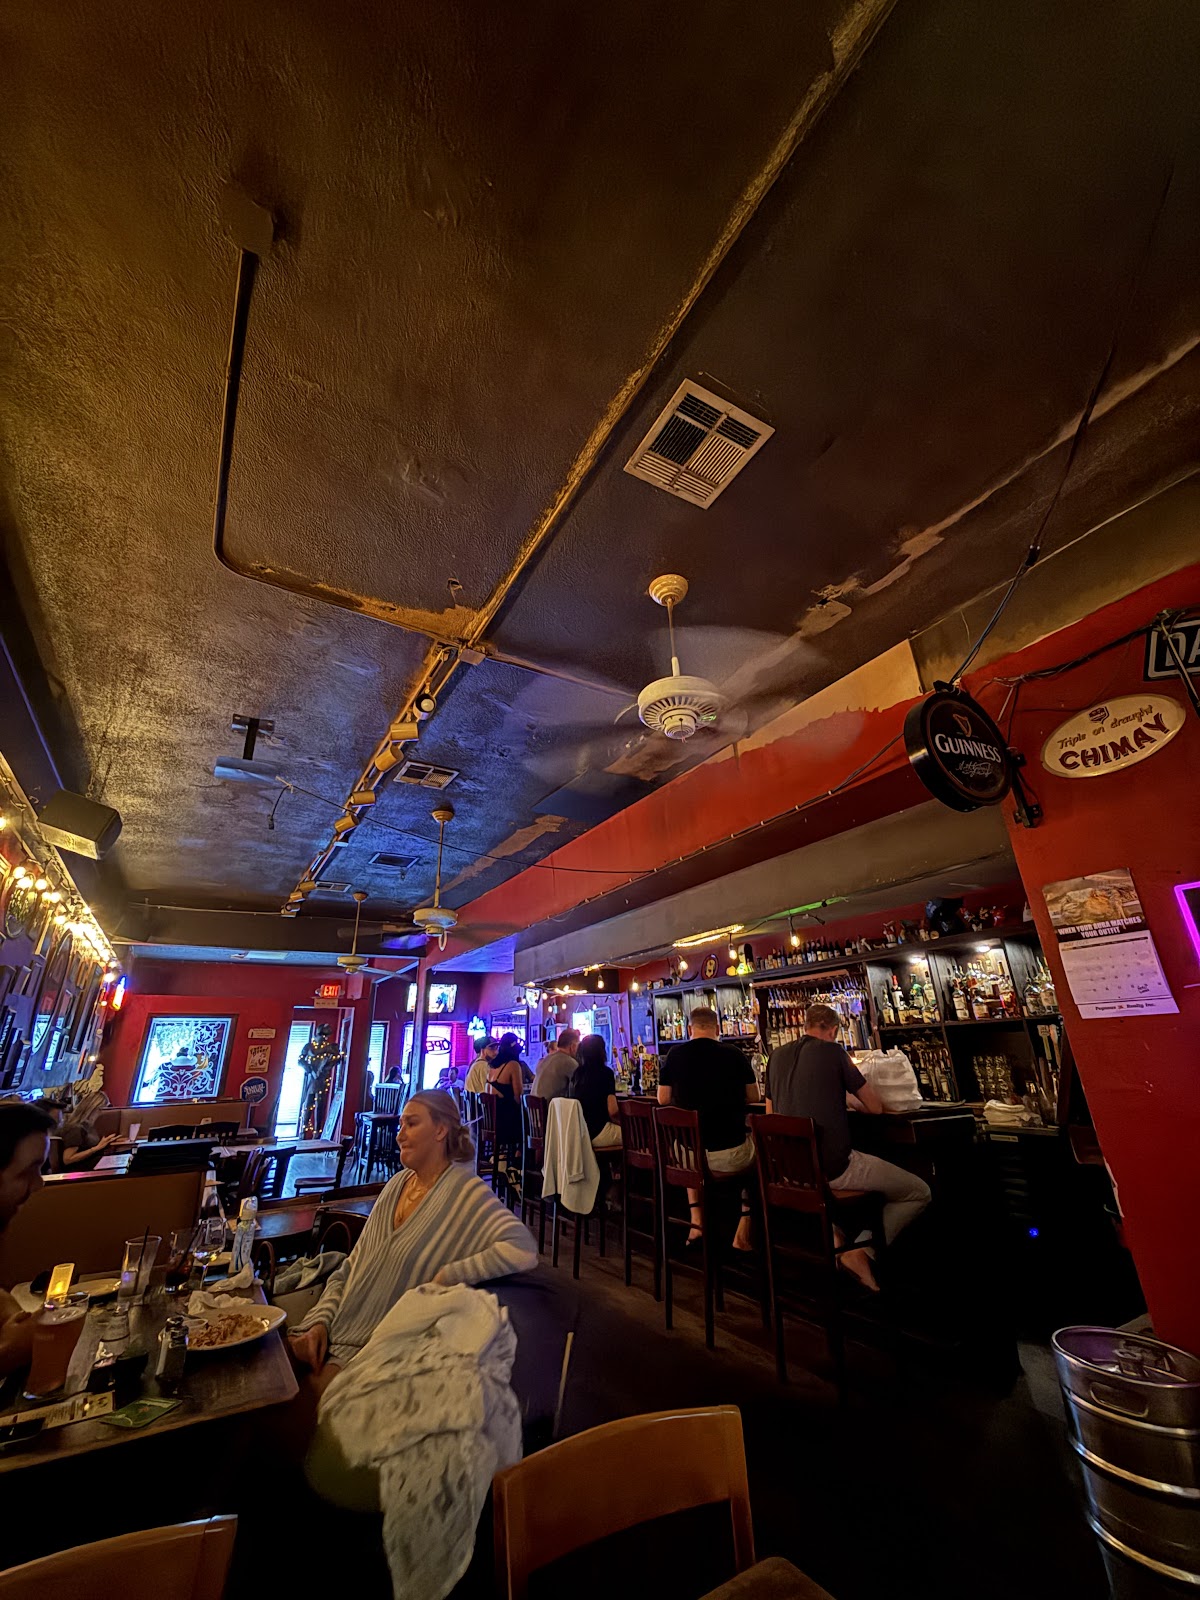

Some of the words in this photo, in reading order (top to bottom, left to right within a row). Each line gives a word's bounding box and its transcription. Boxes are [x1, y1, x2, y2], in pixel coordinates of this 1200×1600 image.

[1092, 726, 1105, 736] on
[1110, 704, 1153, 729] draught
[935, 733, 1001, 763] GUINNESS
[1058, 712, 1170, 770] CHIMAY
[1058, 926, 1076, 935] WHEN
[1076, 924, 1093, 932] YOUR
[1110, 916, 1142, 926] MATCHES
[1080, 929, 1098, 938] YOUR
[1098, 926, 1120, 936] OUTFIT
[323, 985, 338, 996] EXIT
